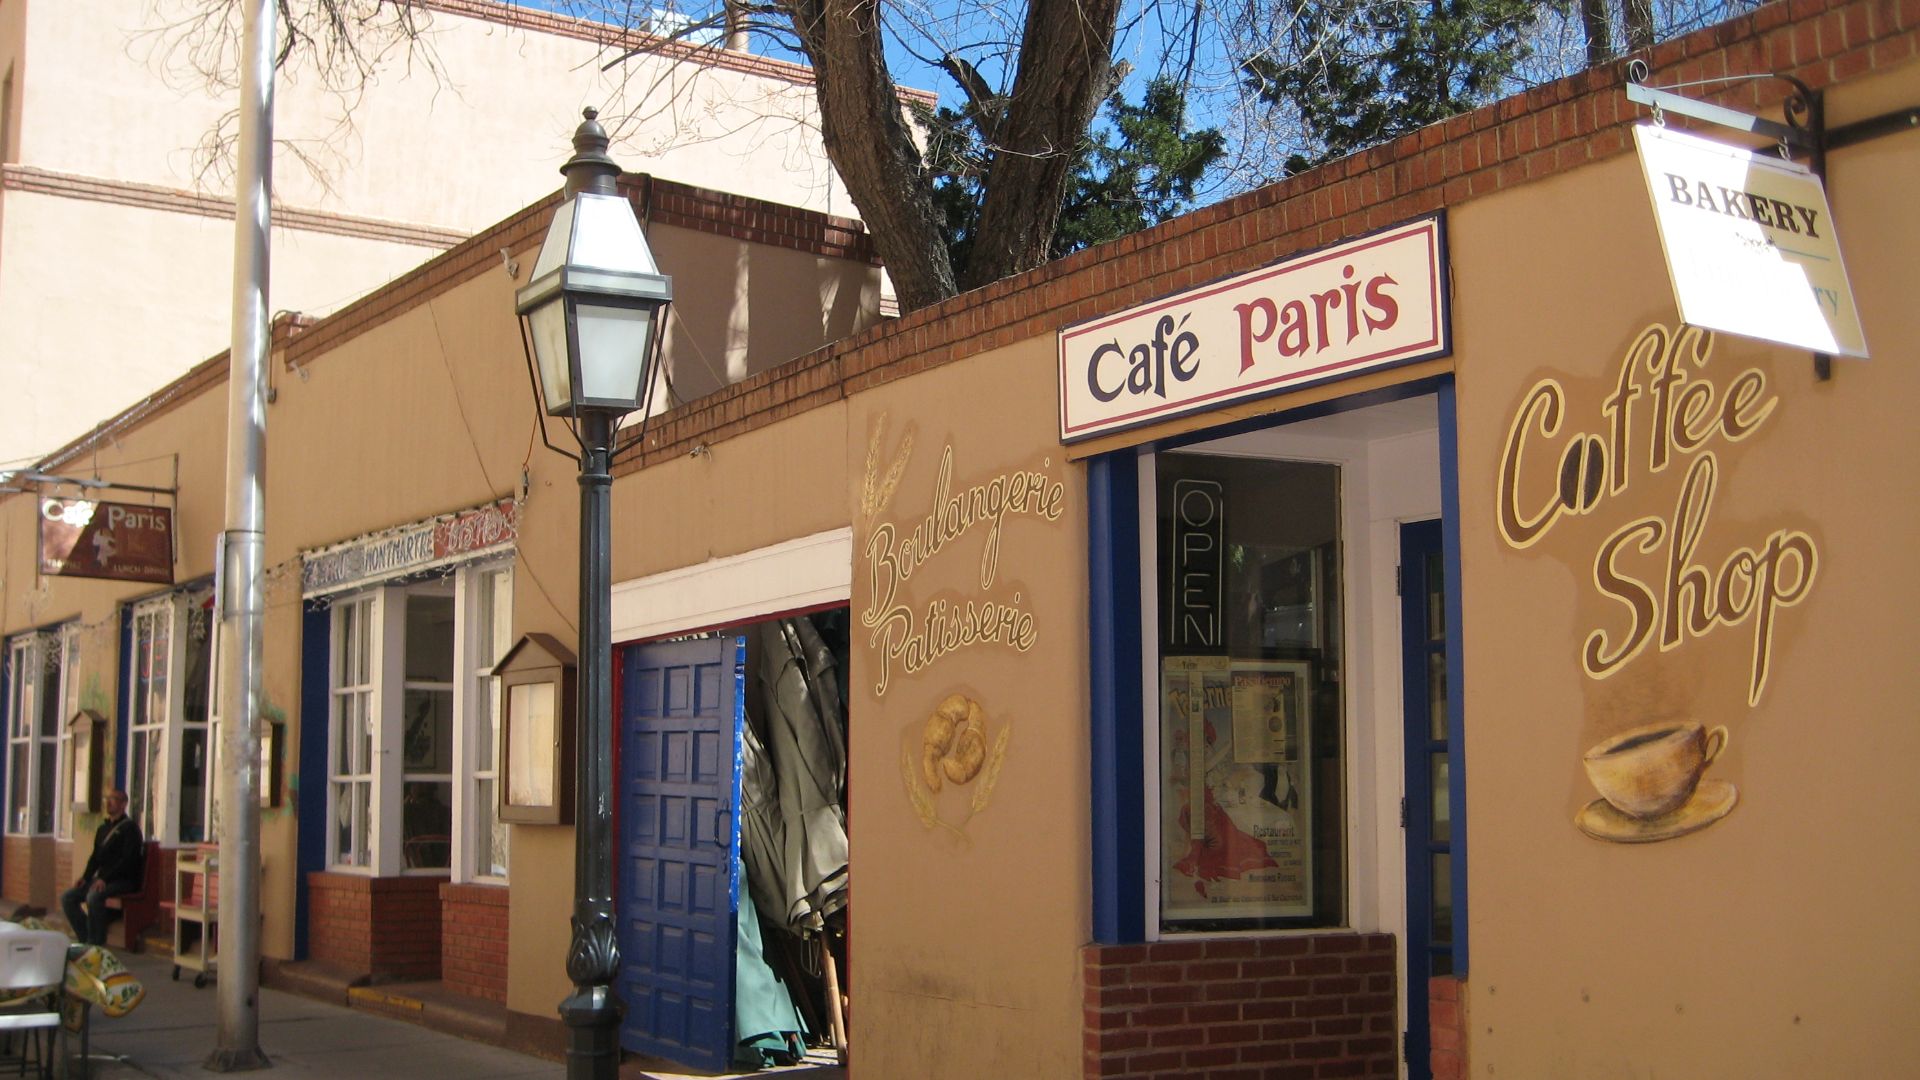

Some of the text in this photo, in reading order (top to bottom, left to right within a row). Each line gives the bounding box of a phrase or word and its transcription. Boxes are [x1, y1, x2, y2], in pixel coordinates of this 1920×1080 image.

[1663, 172, 1819, 238] BAKERY
[1087, 264, 1399, 402] Café Paris
[1496, 323, 1778, 549] Coffee
[108, 505, 166, 531] Paris
[862, 444, 1064, 627] Boulangerie
[1181, 489, 1215, 646] OPEN
[1582, 450, 1818, 707] Shop
[869, 592, 1038, 696] Patisserie
